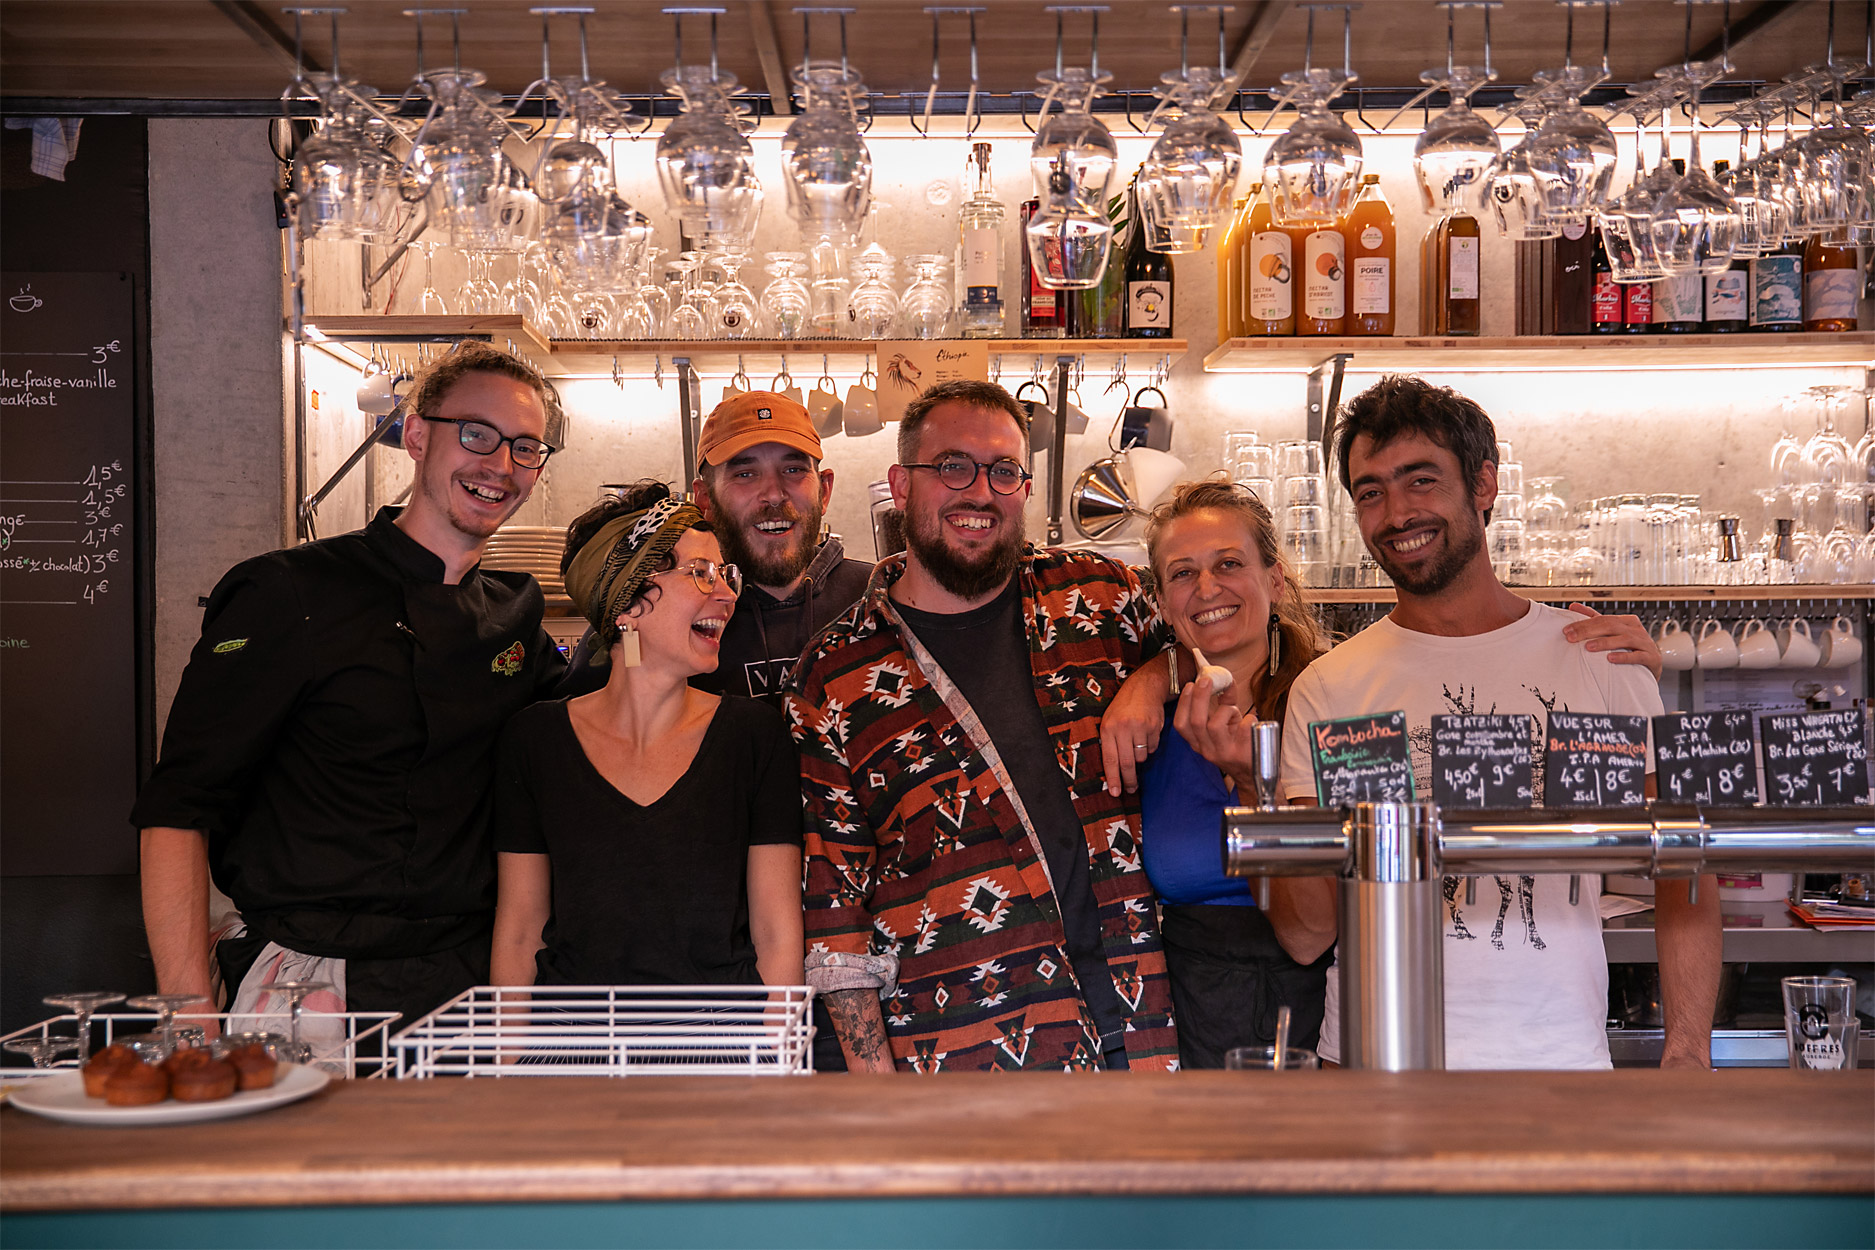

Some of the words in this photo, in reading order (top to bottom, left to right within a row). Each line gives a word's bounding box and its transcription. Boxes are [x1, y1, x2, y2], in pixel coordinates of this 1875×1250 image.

[92, 339, 121, 364] 3€
[0, 368, 117, 392] he-fraise-vanille
[84, 506, 111, 525] 3€
[83, 579, 109, 605] 4€
[1551, 715, 1580, 729] VUE
[1583, 718, 1613, 730] SUR
[1680, 715, 1712, 730] ROY
[1676, 746, 1689, 759] La
[1605, 769, 1632, 790] 8€
[1719, 763, 1744, 794] 8€
